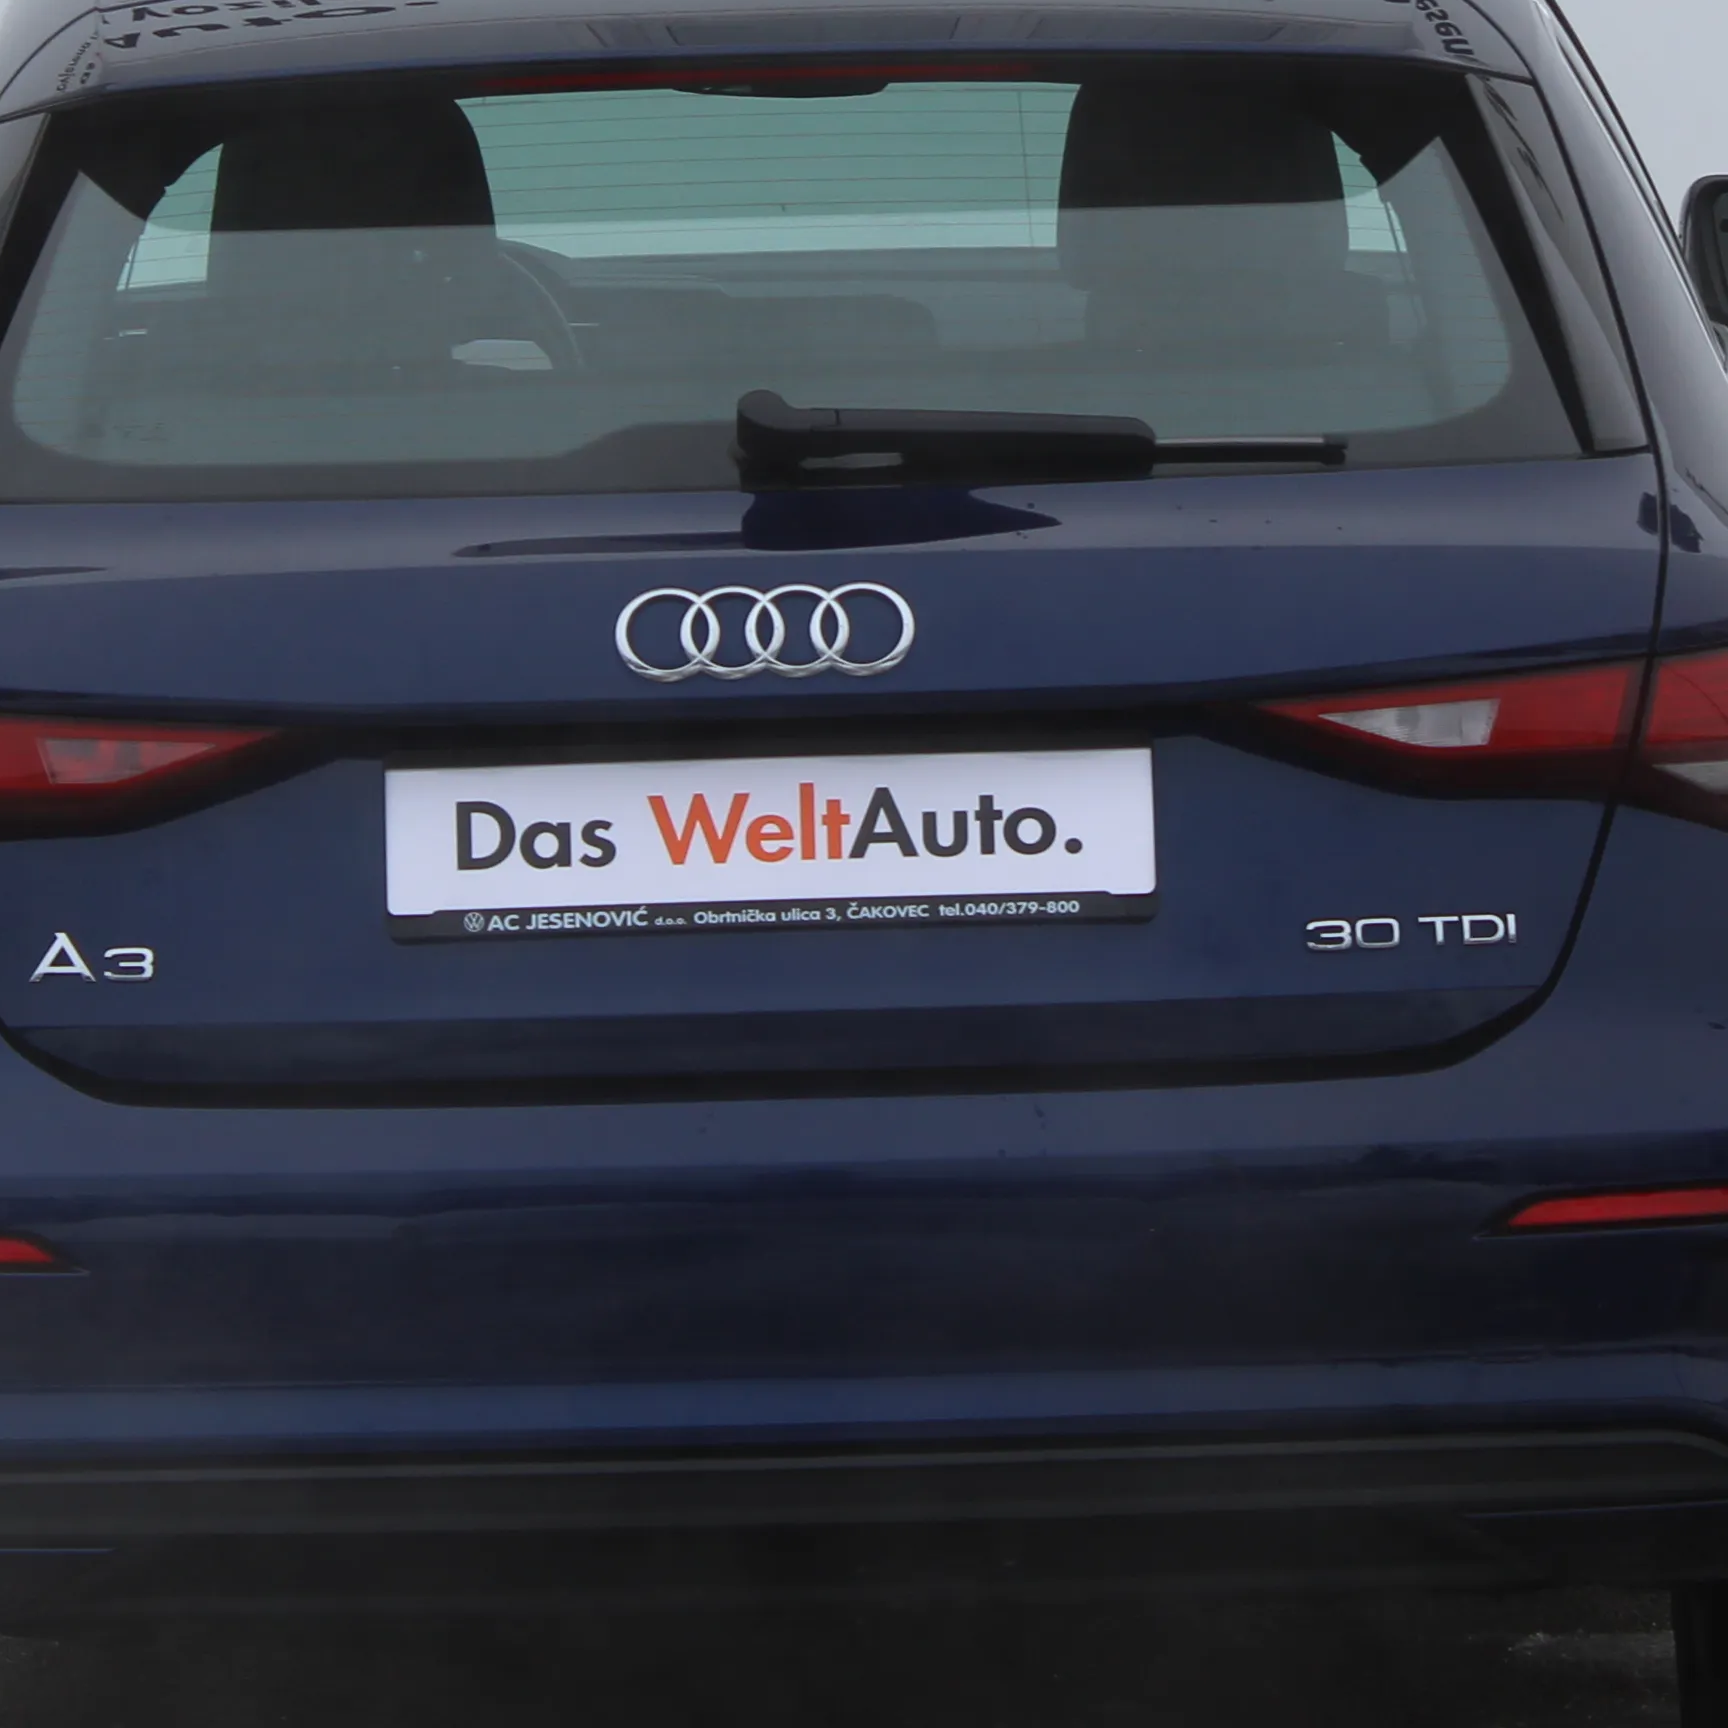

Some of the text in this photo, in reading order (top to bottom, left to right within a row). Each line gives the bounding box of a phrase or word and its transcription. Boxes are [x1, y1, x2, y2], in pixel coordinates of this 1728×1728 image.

[455, 781, 1085, 872] Das WeltAuto.
[486, 913, 521, 932] AC
[525, 905, 650, 931] JESENOVIĆ
[693, 908, 778, 925] Obrtnička
[780, 907, 822, 922] ulica
[824, 907, 843, 923] 3,
[845, 901, 931, 920] ČAKOVEC
[938, 900, 1081, 917] tel.040/379-800
[1305, 913, 1518, 951] 30 TDI
[28, 931, 155, 982] A3
